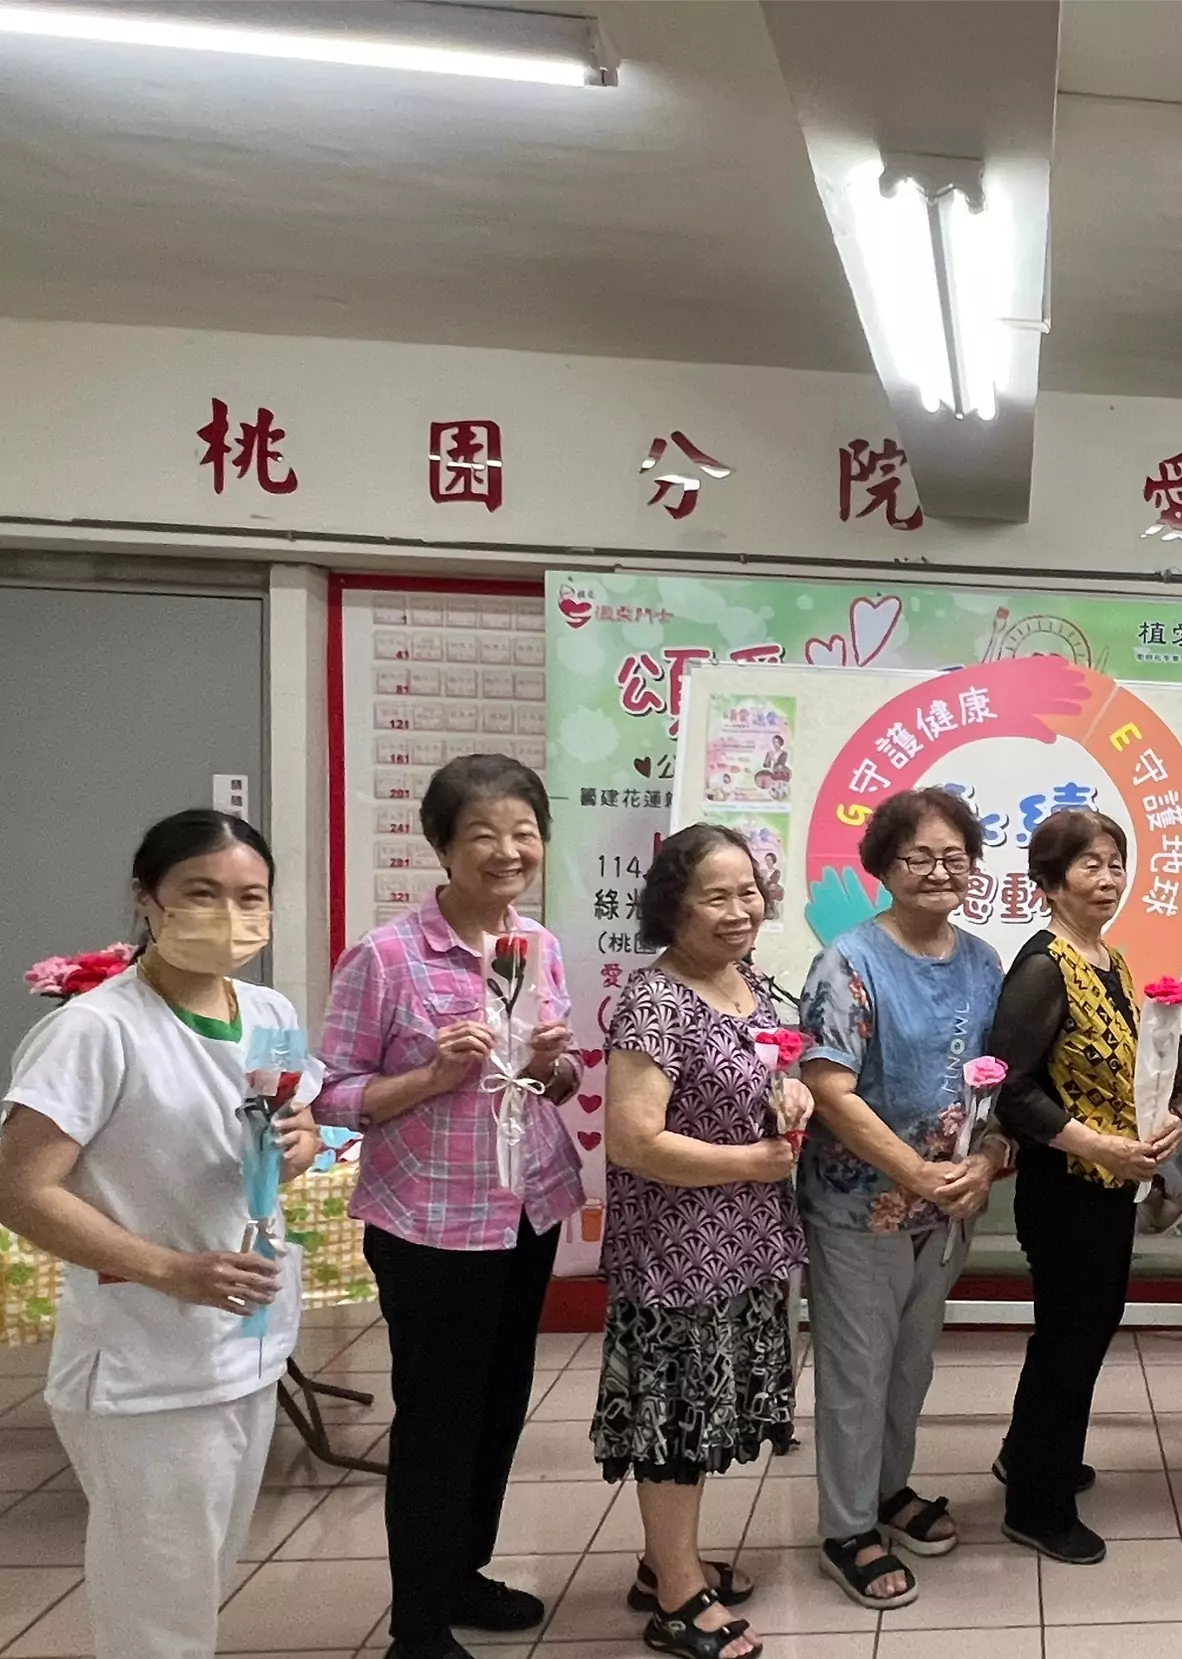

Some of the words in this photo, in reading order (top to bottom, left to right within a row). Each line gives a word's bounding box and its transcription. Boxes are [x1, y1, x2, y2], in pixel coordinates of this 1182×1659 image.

[390, 720, 410, 730] 121
[598, 855, 646, 878] 114
[390, 892, 410, 902] 321
